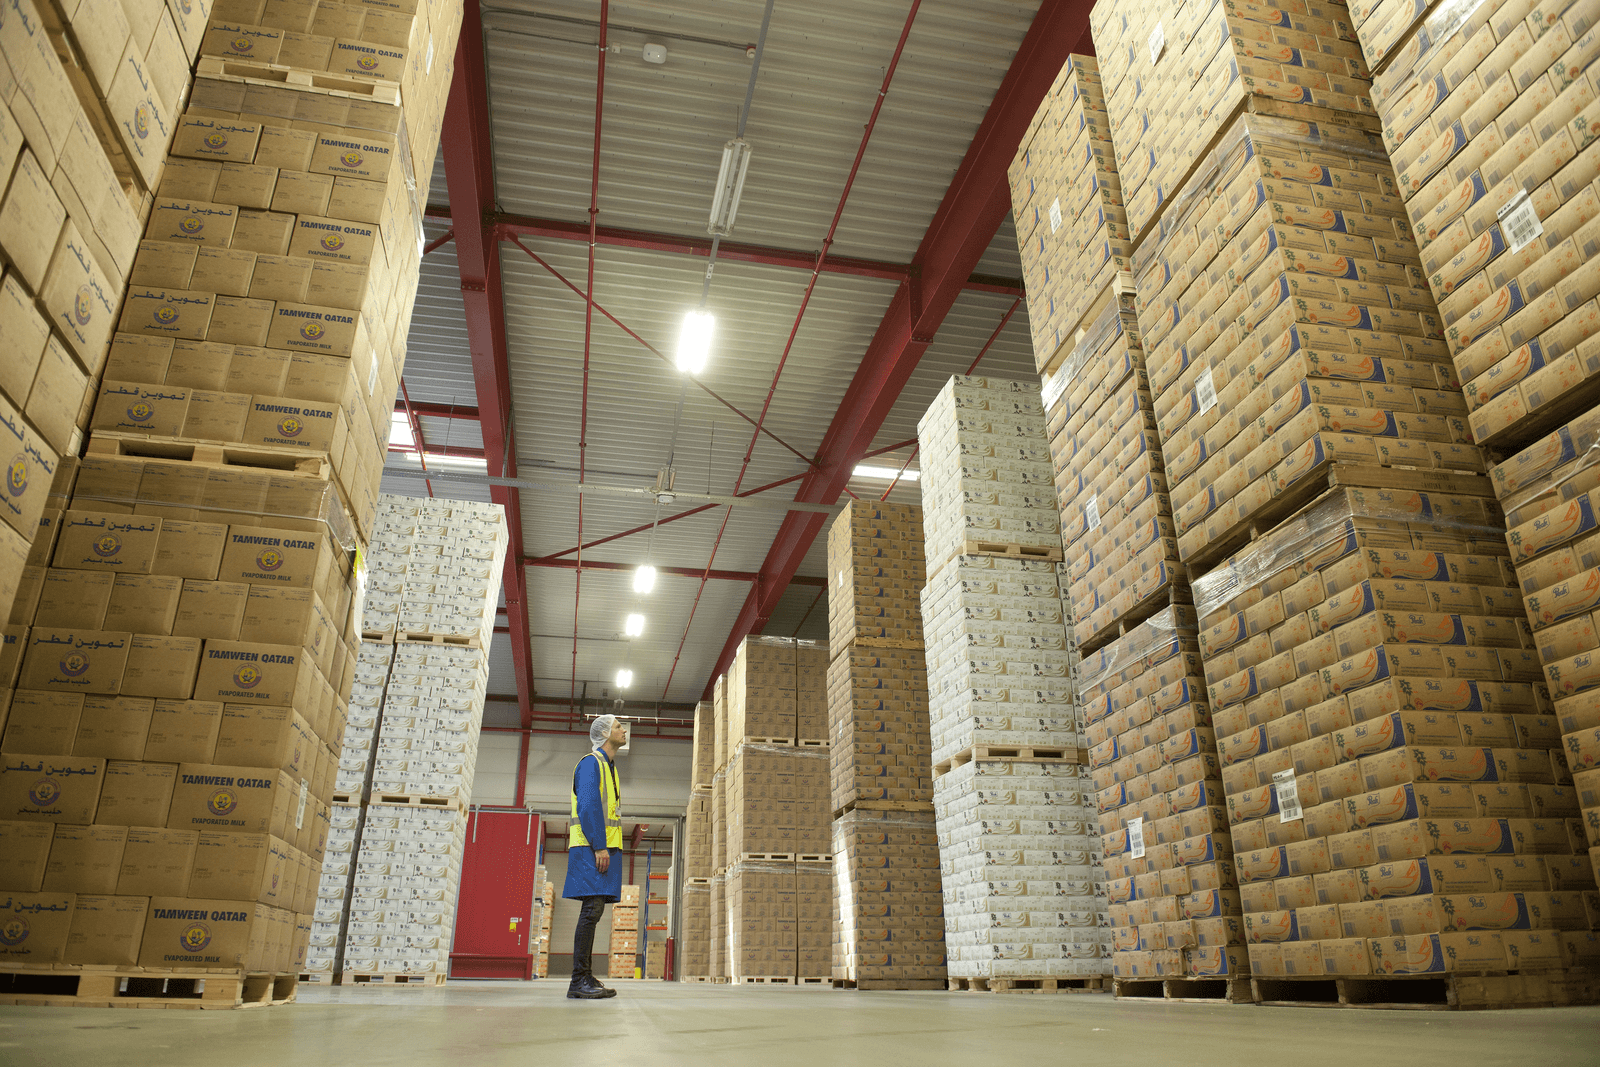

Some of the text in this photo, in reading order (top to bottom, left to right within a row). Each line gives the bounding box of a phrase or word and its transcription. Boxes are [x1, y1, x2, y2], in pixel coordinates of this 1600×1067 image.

[210, 24, 279, 38] تموين قطر
[338, 43, 403, 59] TAMWEEN QATAR
[346, 68, 373, 77] EVAPORATED
[183, 119, 255, 133] تموين قطر
[321, 138, 389, 154] TAMWEEN QATAR
[328, 166, 358, 174] EVAPORATED
[157, 203, 232, 216] تموين قطر
[300, 220, 372, 237] TAMWEEN QATAR
[308, 250, 338, 259] EVAPORATED
[131, 290, 209, 305] تموين قطر
[279, 308, 353, 324] TAMWEEN QATAR
[287, 340, 318, 349] EVAPORATED
[103, 386, 186, 400] تموين قطر
[255, 403, 333, 419] TAMWEEN QATAR
[0, 413, 25, 442] قط
[264, 437, 296, 446] EVAPORATED
[67, 516, 155, 532] تموين قطر
[232, 534, 316, 550] TAMWEEN QATAR
[242, 572, 276, 580] EVAPORATED
[33, 634, 125, 649] تموين قطر
[208, 649, 295, 665] TAMWEEN QATAR
[218, 689, 254, 698] EVAPORATED
[2, 761, 44, 773] قطر
[46, 764, 97, 776] تموين
[182, 775, 272, 789] TAMWEEN QATAR
[192, 817, 229, 826] EVAPORATED
[14, 901, 68, 913] تموين
[154, 909, 247, 922] TAMWEEN QATAR
[164, 954, 203, 963] EVAPORATED
